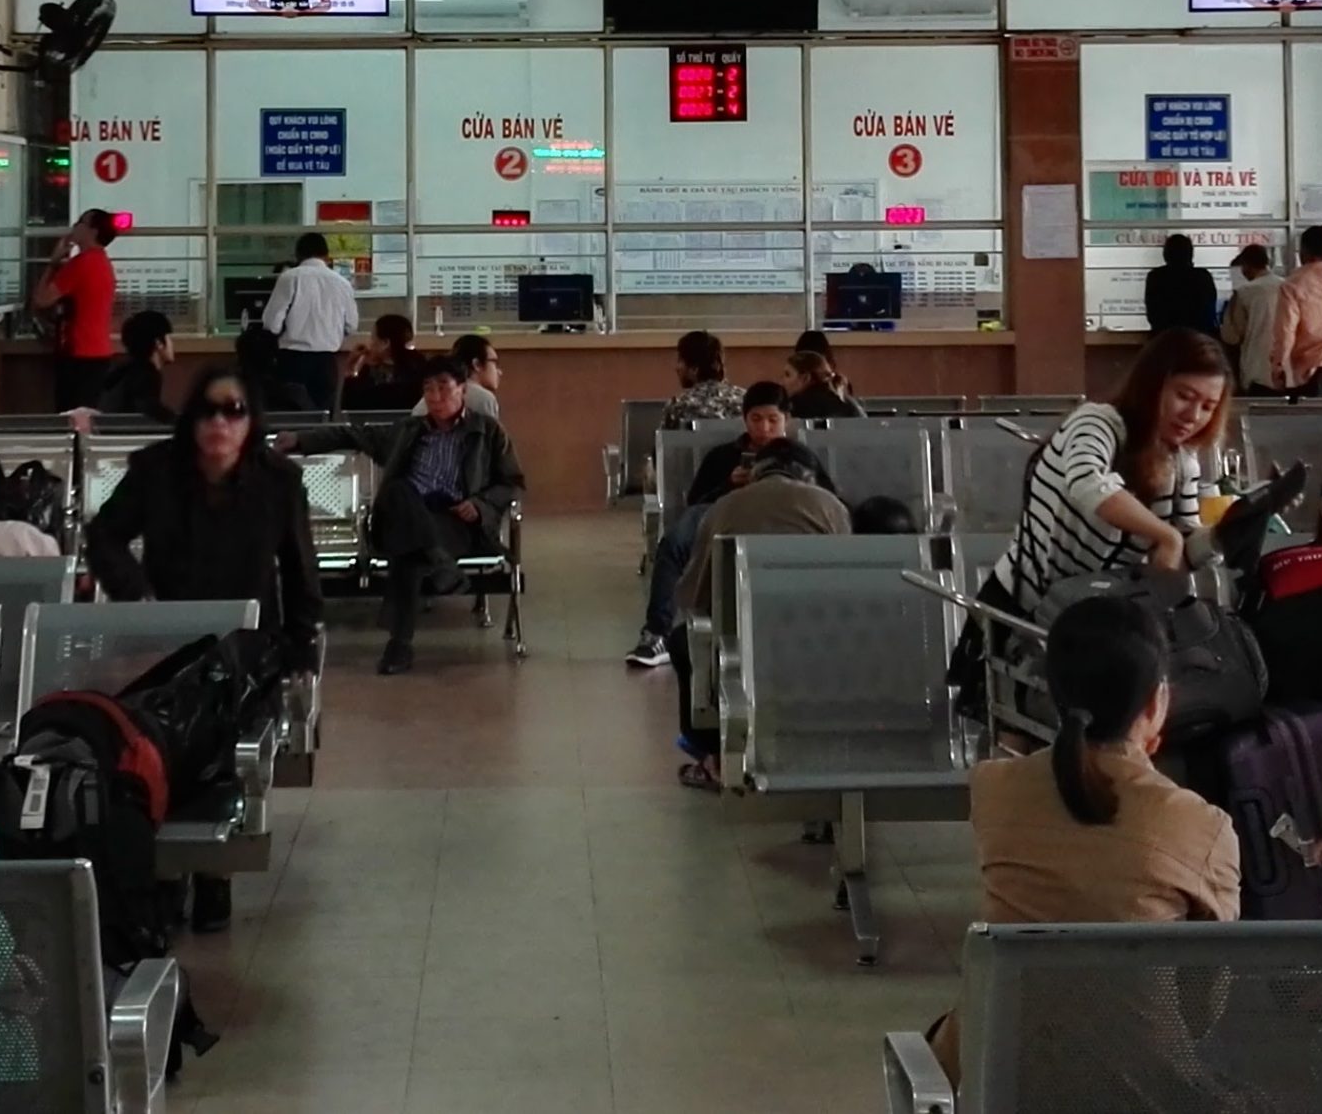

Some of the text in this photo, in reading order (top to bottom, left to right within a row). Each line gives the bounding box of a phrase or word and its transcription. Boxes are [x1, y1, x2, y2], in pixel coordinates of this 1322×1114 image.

[728, 68, 738, 81] 2
[728, 85, 738, 99] 2
[728, 103, 738, 115] 4
[99, 115, 132, 141] BÁN
[140, 115, 162, 141] VÉ
[462, 111, 563, 139] CỬA BÁN VÉ
[853, 108, 955, 136] CỬA BÁN VÉ
[101, 153, 118, 180] 1
[501, 150, 522, 175] 2
[895, 148, 917, 175] 3
[1119, 165, 1149, 187] CỬA
[1183, 167, 1203, 186] VÀ
[1208, 165, 1235, 186] TRẢ
[1239, 167, 1258, 186] VÉ
[1213, 231, 1232, 244] ƯU
[1236, 230, 1271, 244] TIÊN
